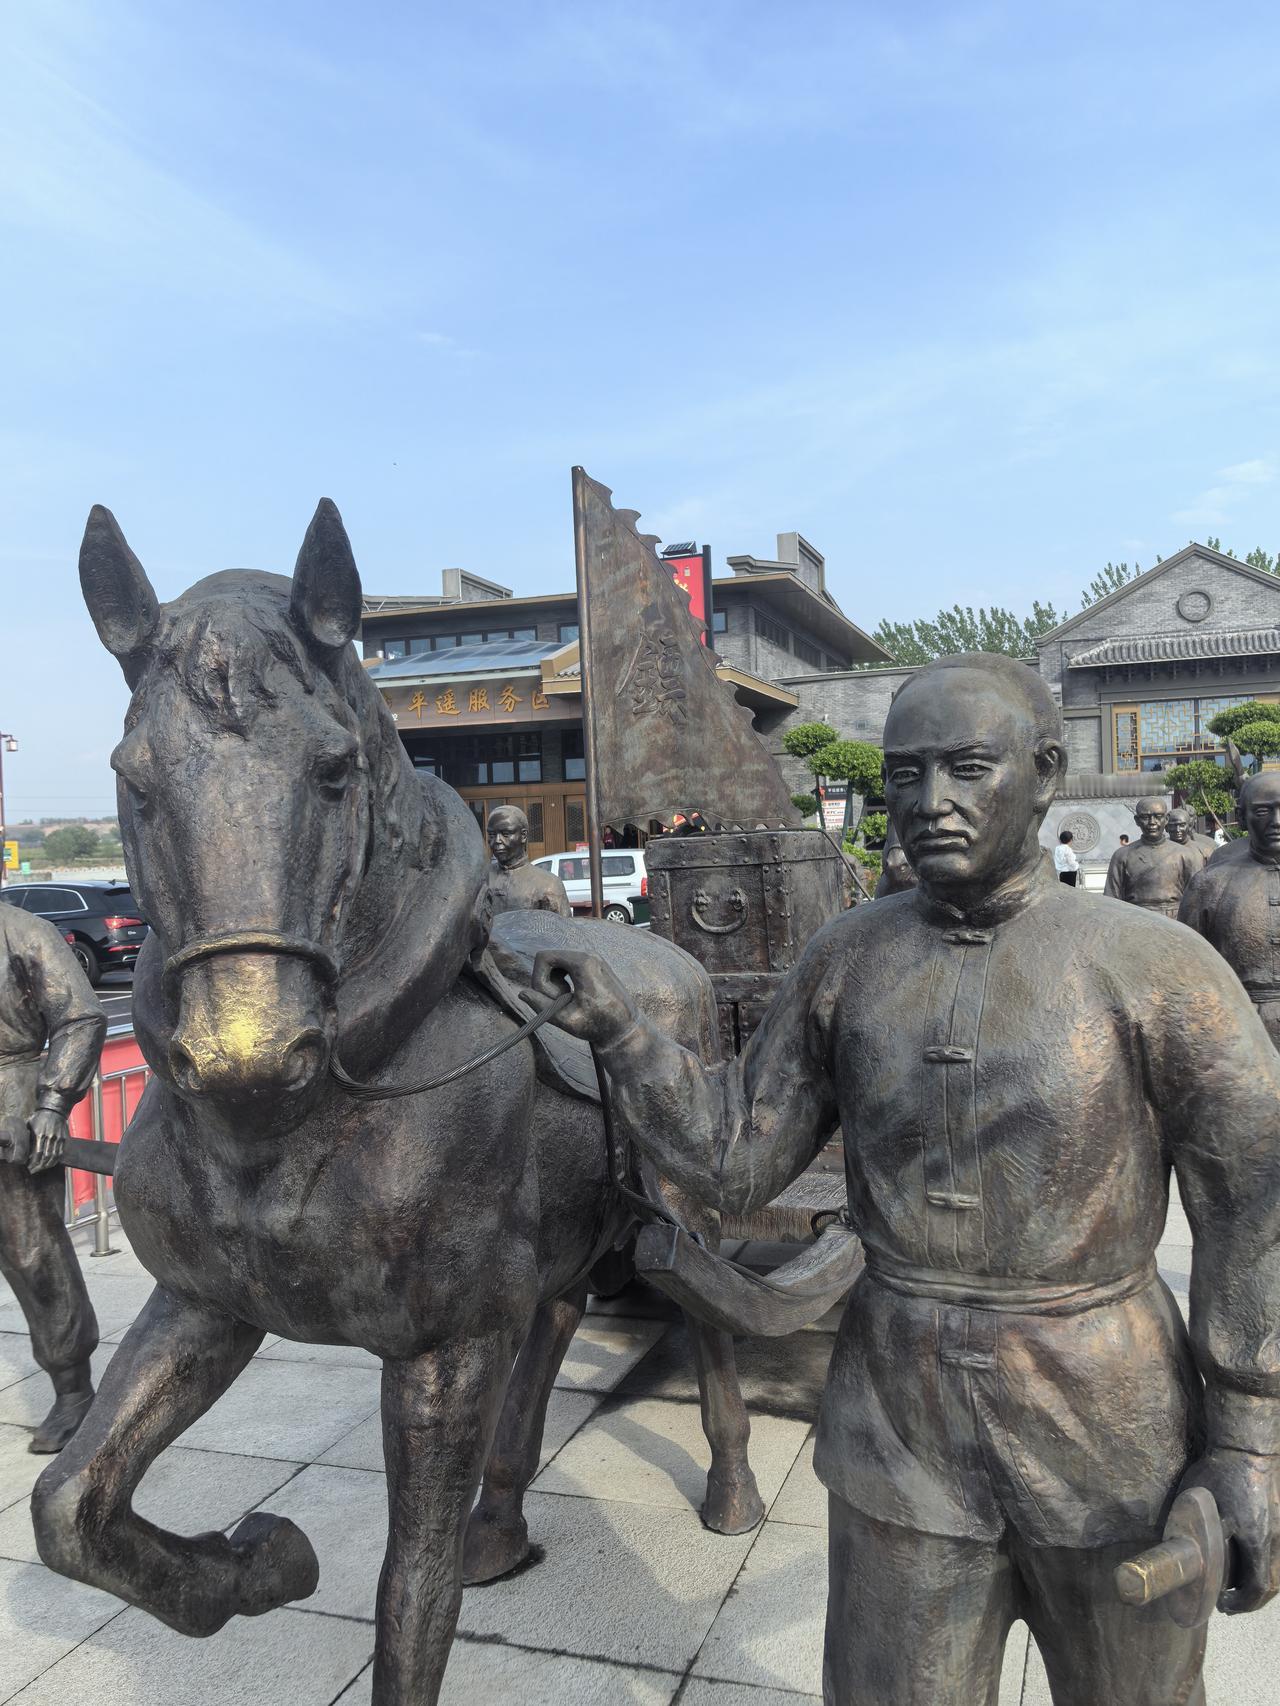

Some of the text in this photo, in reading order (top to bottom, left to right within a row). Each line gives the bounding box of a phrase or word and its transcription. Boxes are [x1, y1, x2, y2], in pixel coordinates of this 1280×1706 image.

[408, 684, 550, 719] 平遥服务区
